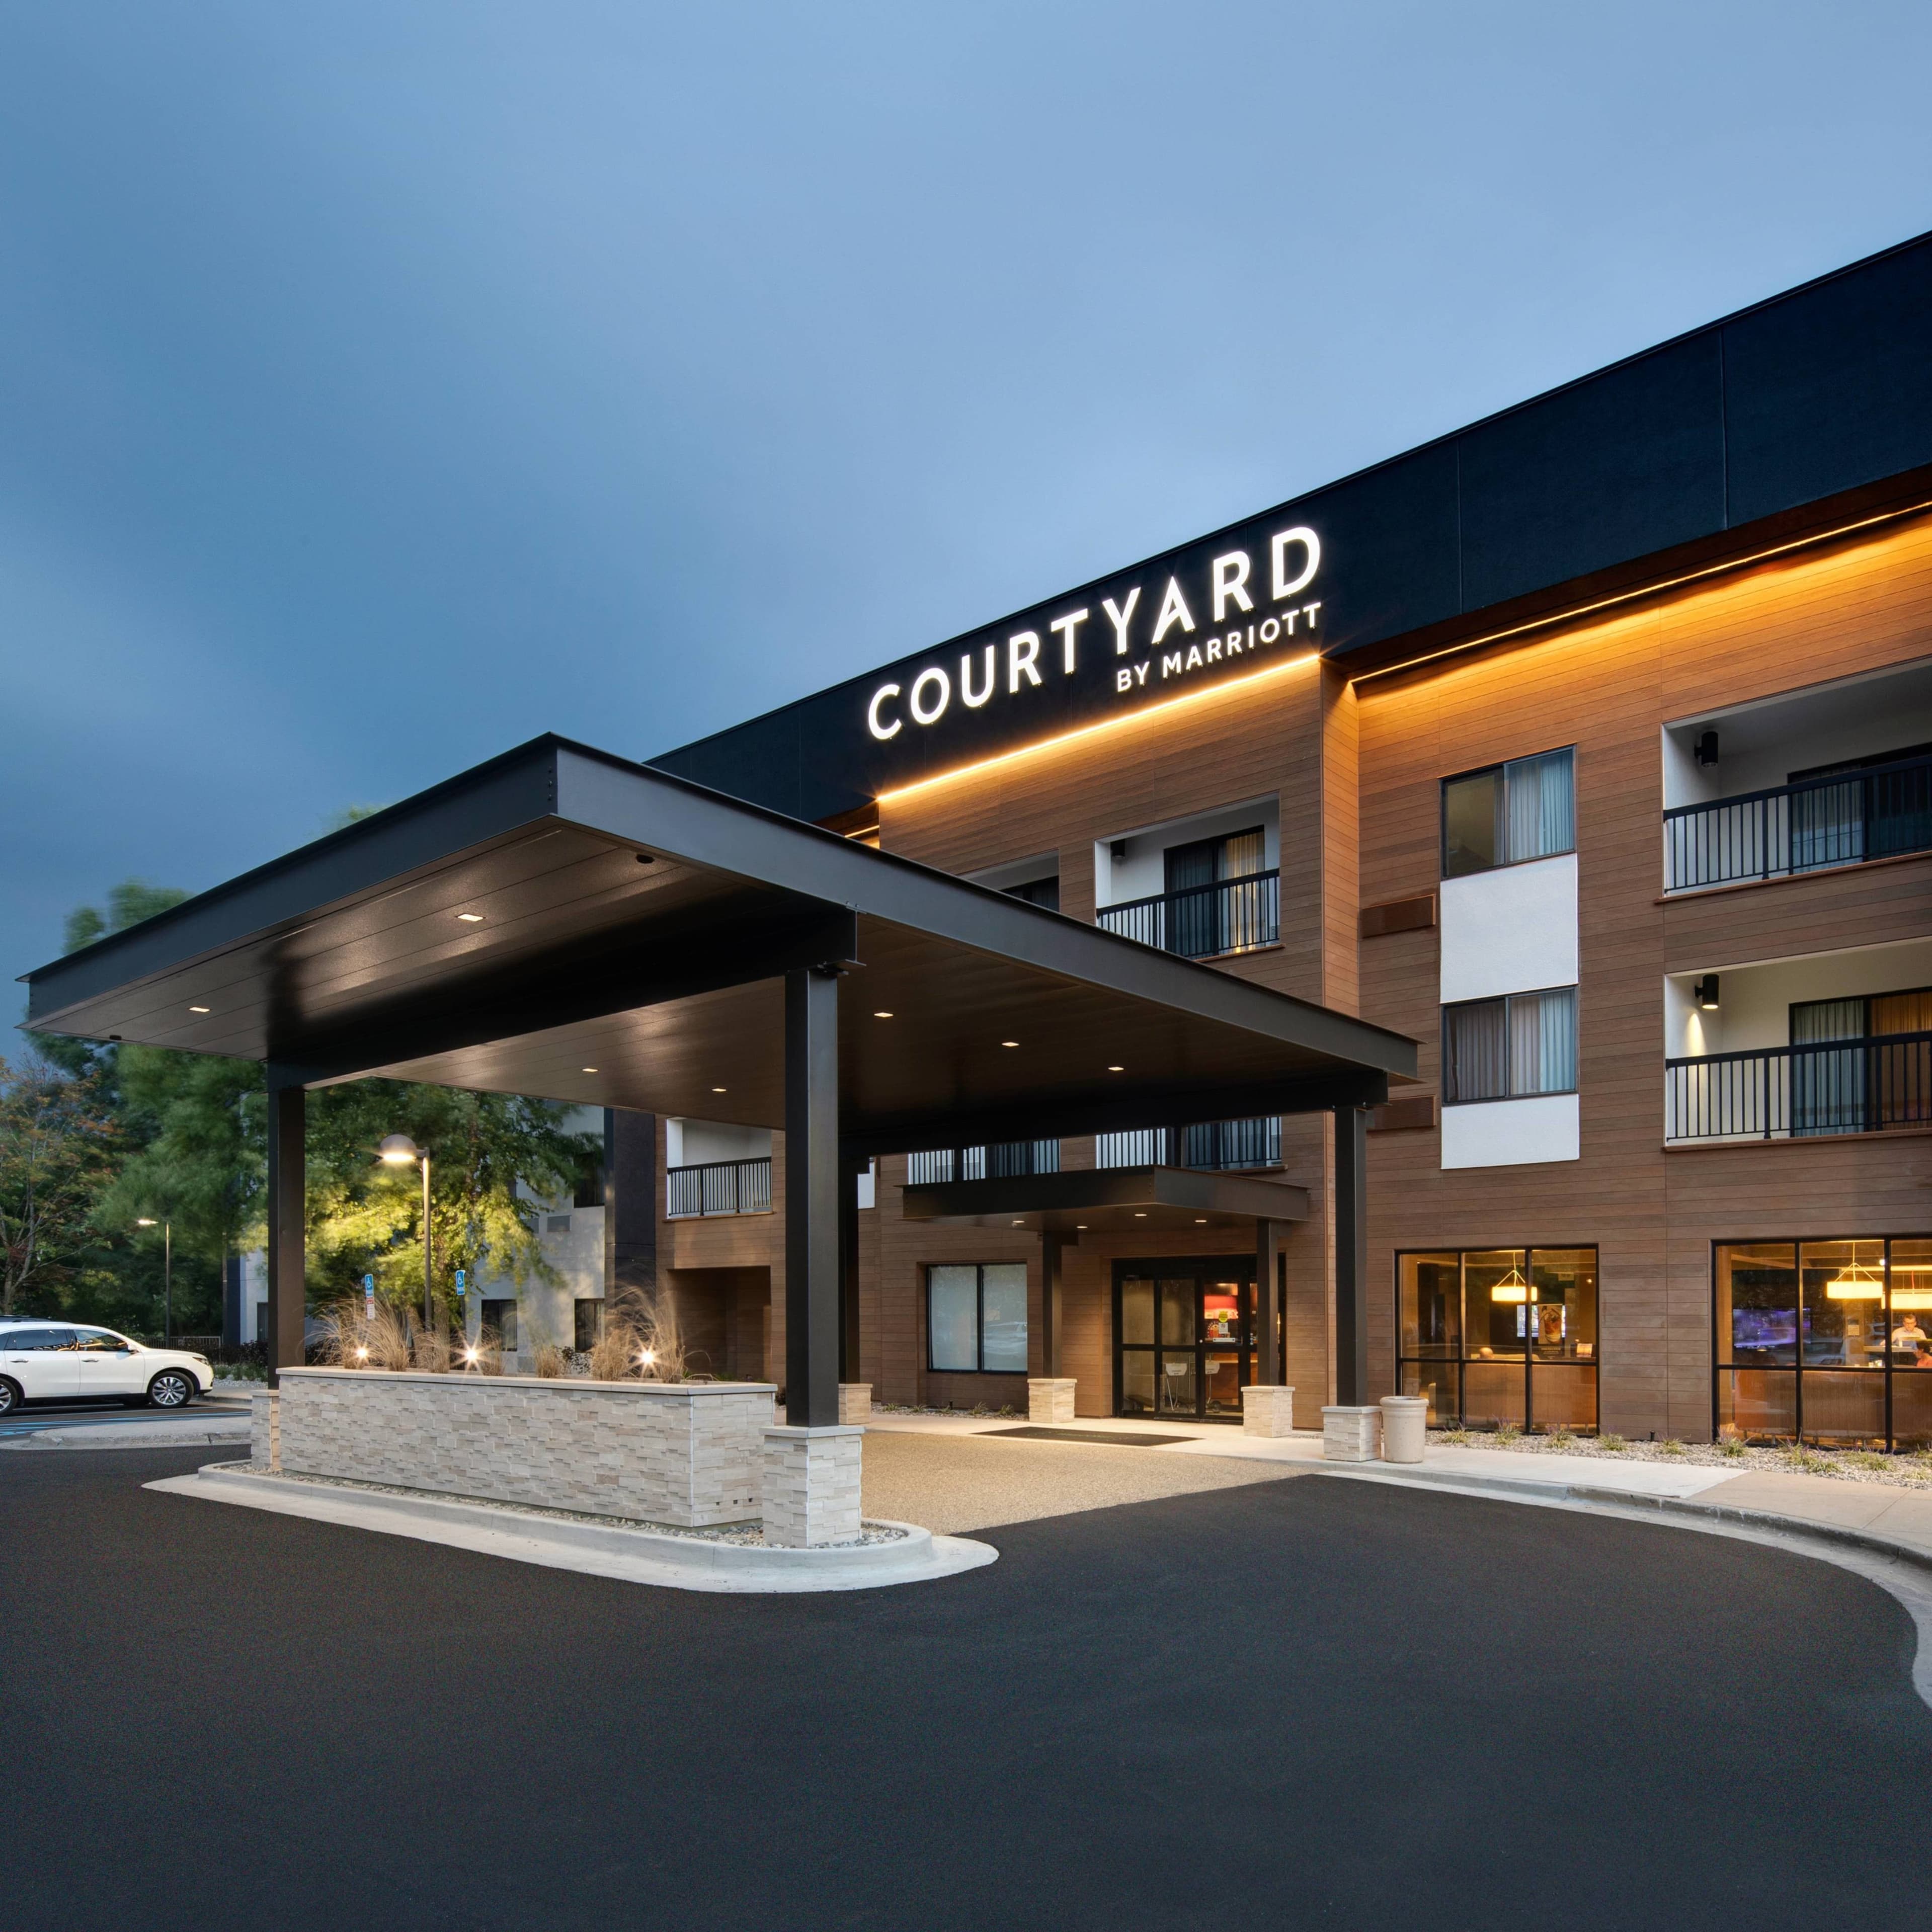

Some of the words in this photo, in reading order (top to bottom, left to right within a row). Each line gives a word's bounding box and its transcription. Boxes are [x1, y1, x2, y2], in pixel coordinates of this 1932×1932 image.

[868, 526, 1321, 740] COURTYARD
[1117, 661, 1150, 692] BY
[1163, 602, 1322, 678] MARRIOTT
